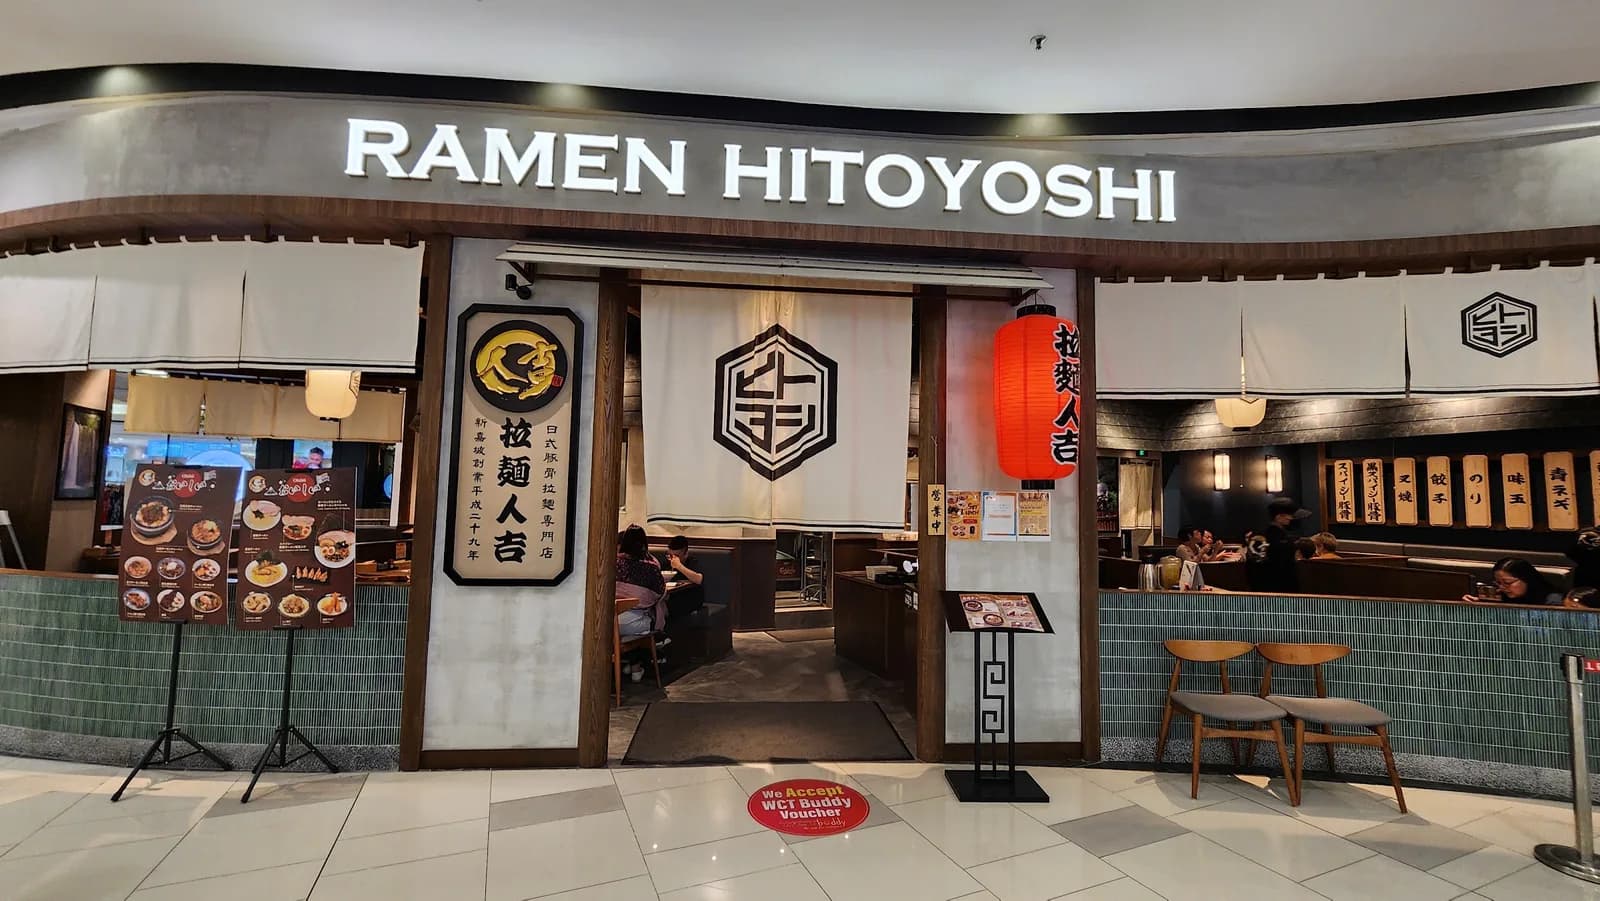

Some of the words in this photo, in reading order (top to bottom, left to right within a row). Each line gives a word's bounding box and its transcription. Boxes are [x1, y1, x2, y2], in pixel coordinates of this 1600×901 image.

[345, 117, 687, 197] RAMEN
[722, 143, 1177, 223] HITOYOSHI
[1469, 473, 1484, 505] のり
[762, 790, 783, 799] We
[785, 785, 844, 797] Accept
[761, 799, 796, 811] WCT
[798, 797, 852, 808] Buddy
[780, 807, 841, 820] Voucher
